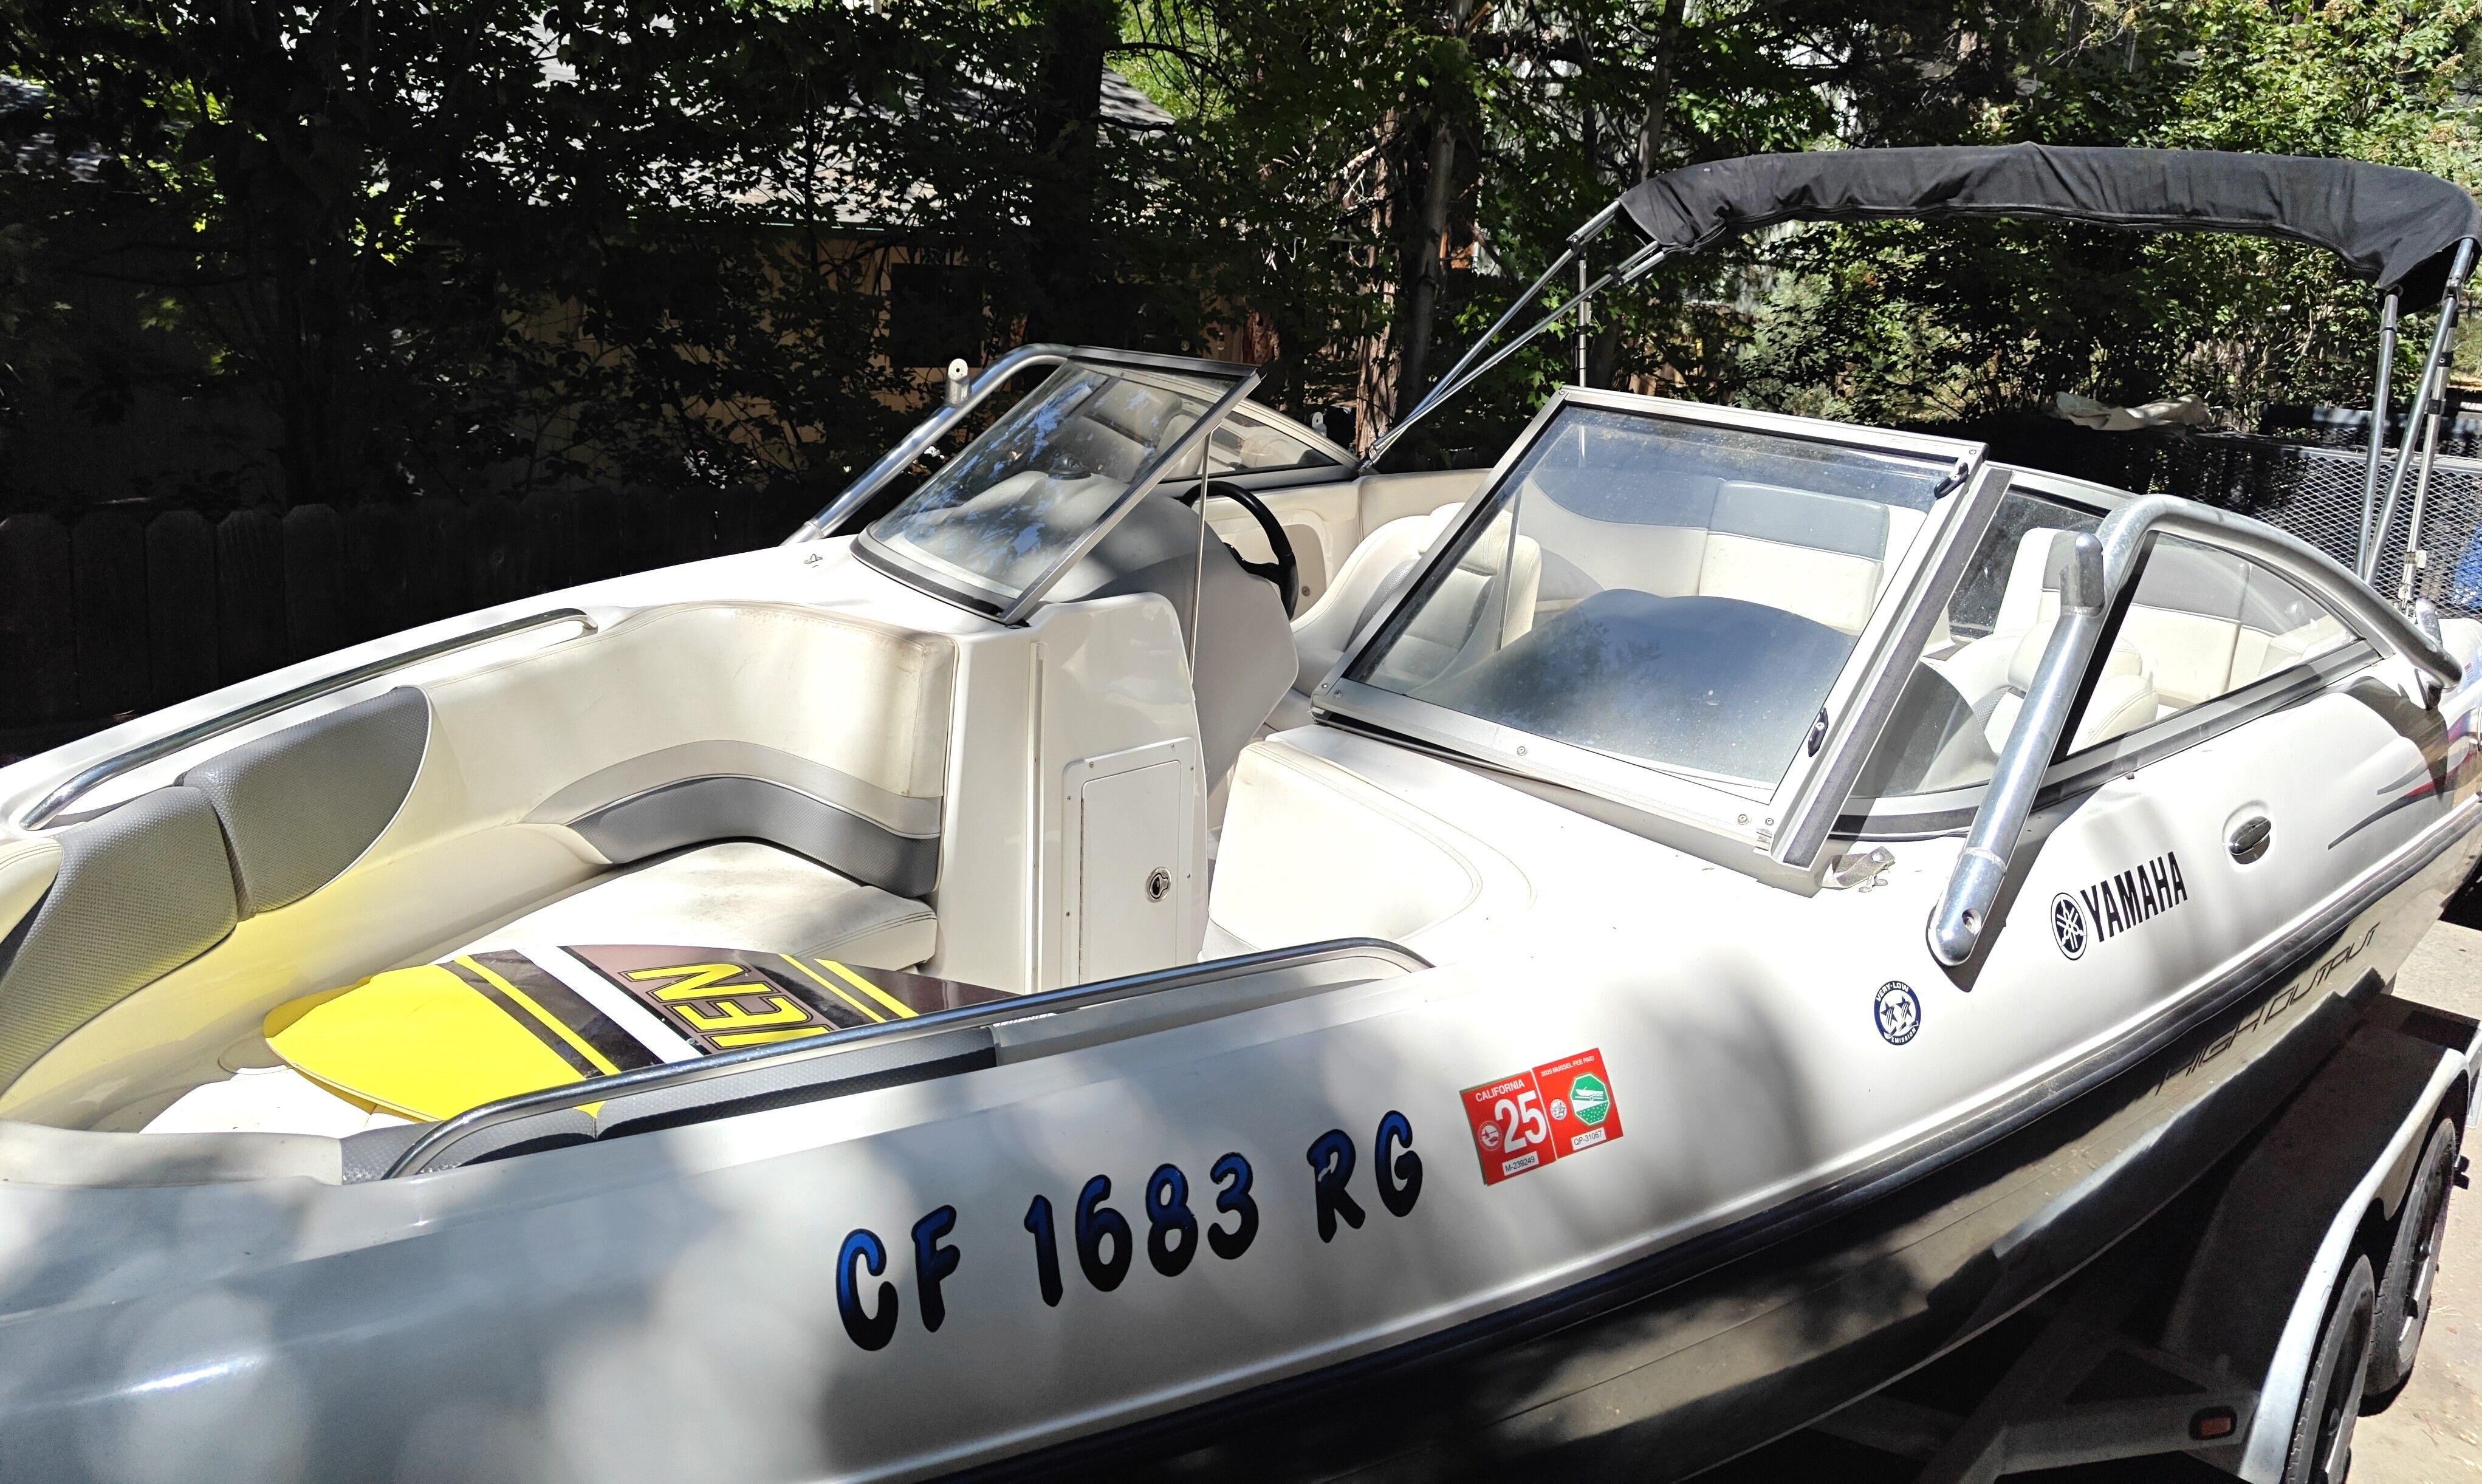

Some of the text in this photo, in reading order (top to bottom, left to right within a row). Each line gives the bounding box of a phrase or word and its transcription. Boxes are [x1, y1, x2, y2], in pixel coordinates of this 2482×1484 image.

[2080, 851, 2188, 943] YAMAHA
[2155, 921, 2381, 1096] HIGH OUTPUT
[1891, 1027, 1917, 1044] EMISSION
[1552, 1062, 1573, 1073] MUSSEL
[1583, 1055, 1595, 1064] PAID
[1475, 1079, 1526, 1102] CALIFORNIA
[1494, 1090, 1547, 1154] 25
[1574, 1130, 1602, 1146] QP-31067
[1504, 1155, 1535, 1172] M-239249
[835, 1109, 1424, 1352] CF 1683 RG
